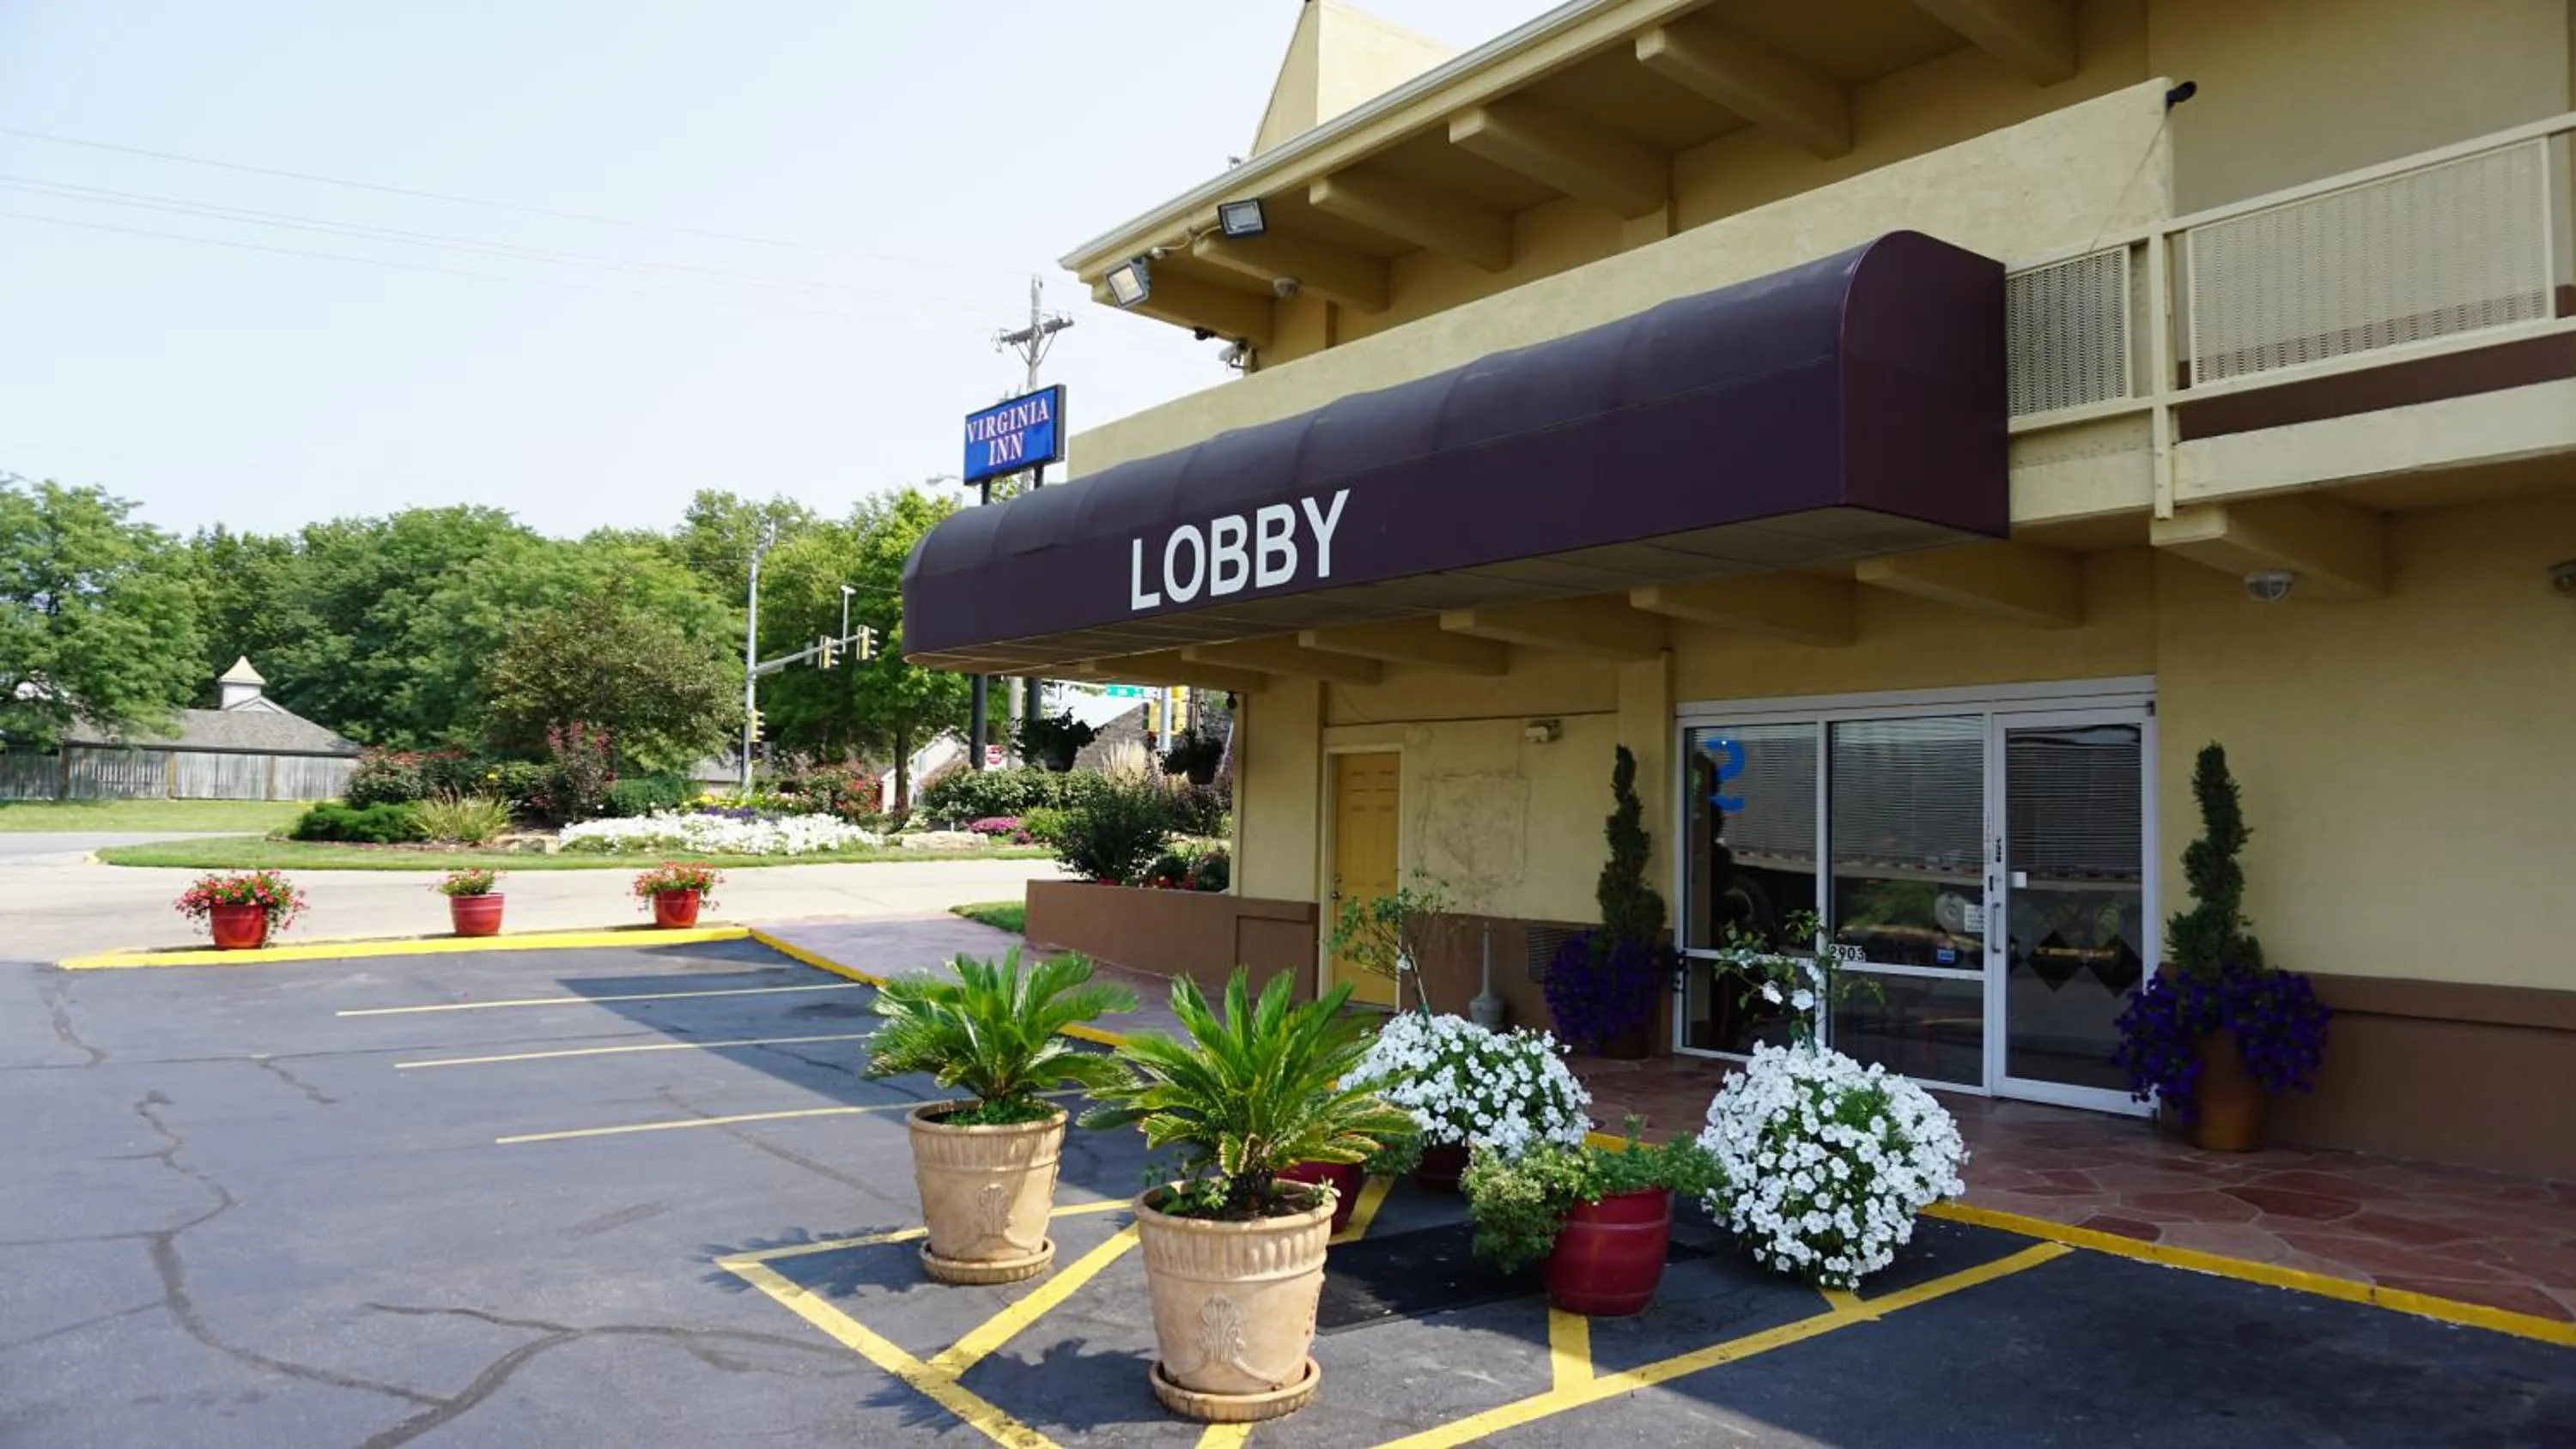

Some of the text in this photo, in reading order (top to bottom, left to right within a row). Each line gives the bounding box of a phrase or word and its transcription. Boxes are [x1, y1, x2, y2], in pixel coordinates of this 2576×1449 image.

[967, 397, 1049, 444] VIRGINIA
[988, 432, 1024, 466] INN
[1131, 488, 1350, 611] LOBBY
[1830, 945, 1864, 961] 2903
